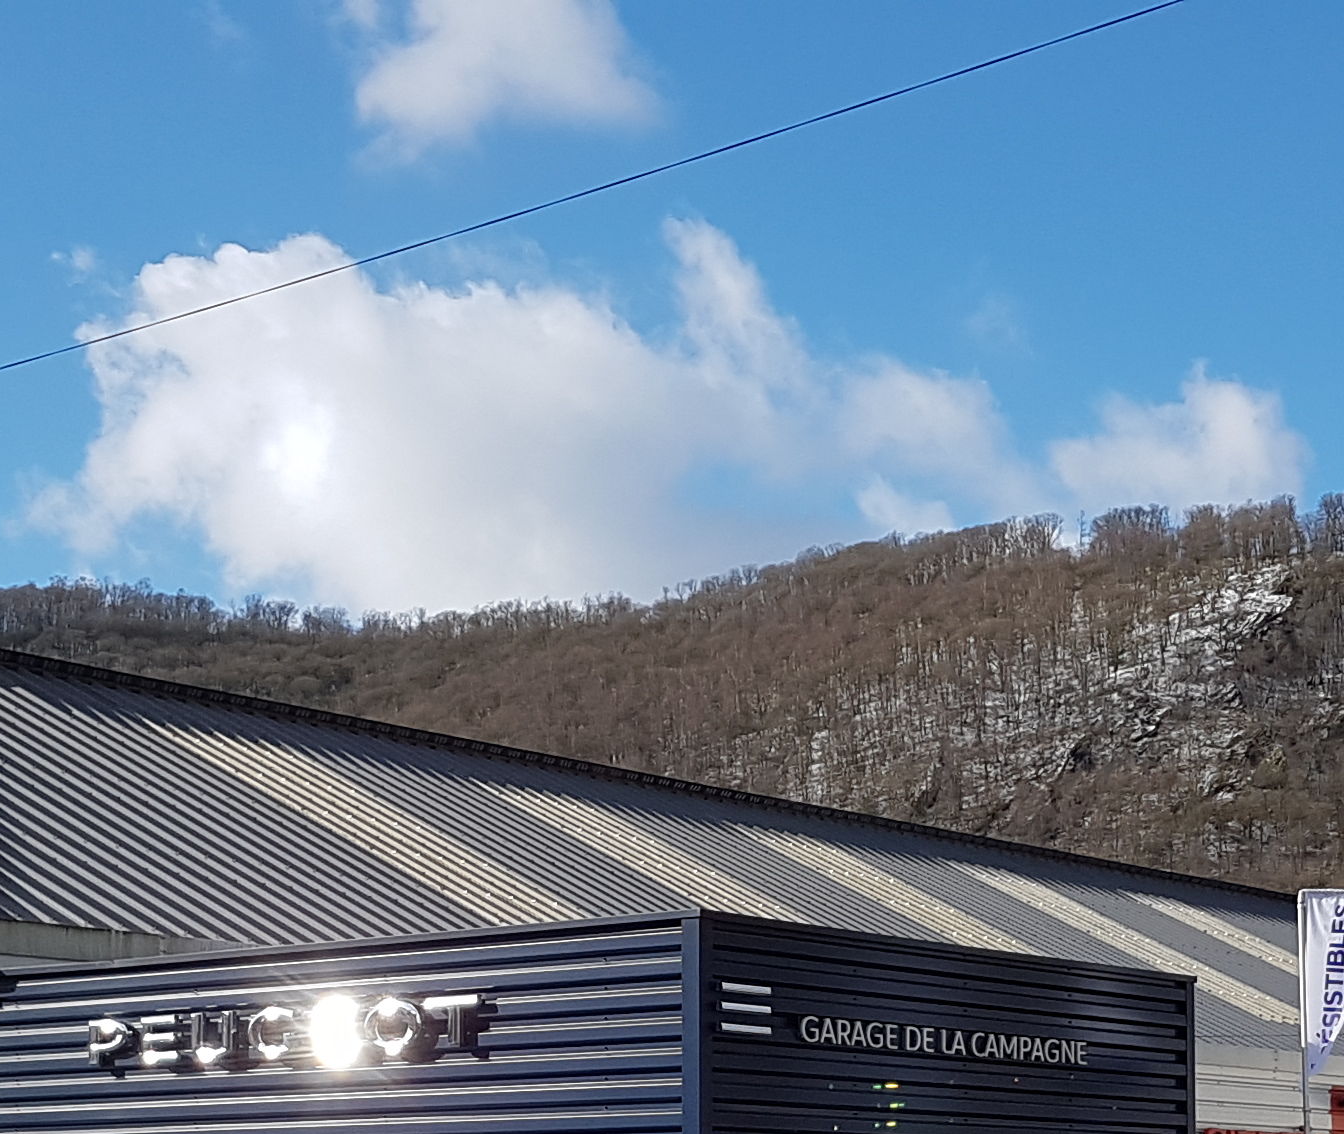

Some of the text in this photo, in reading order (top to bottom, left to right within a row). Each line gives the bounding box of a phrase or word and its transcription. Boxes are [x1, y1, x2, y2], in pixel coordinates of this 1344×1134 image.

[88, 992, 488, 1068] PEUGOT
[801, 1016, 1088, 1065] GARAGE DE LA CAMPAGNE
